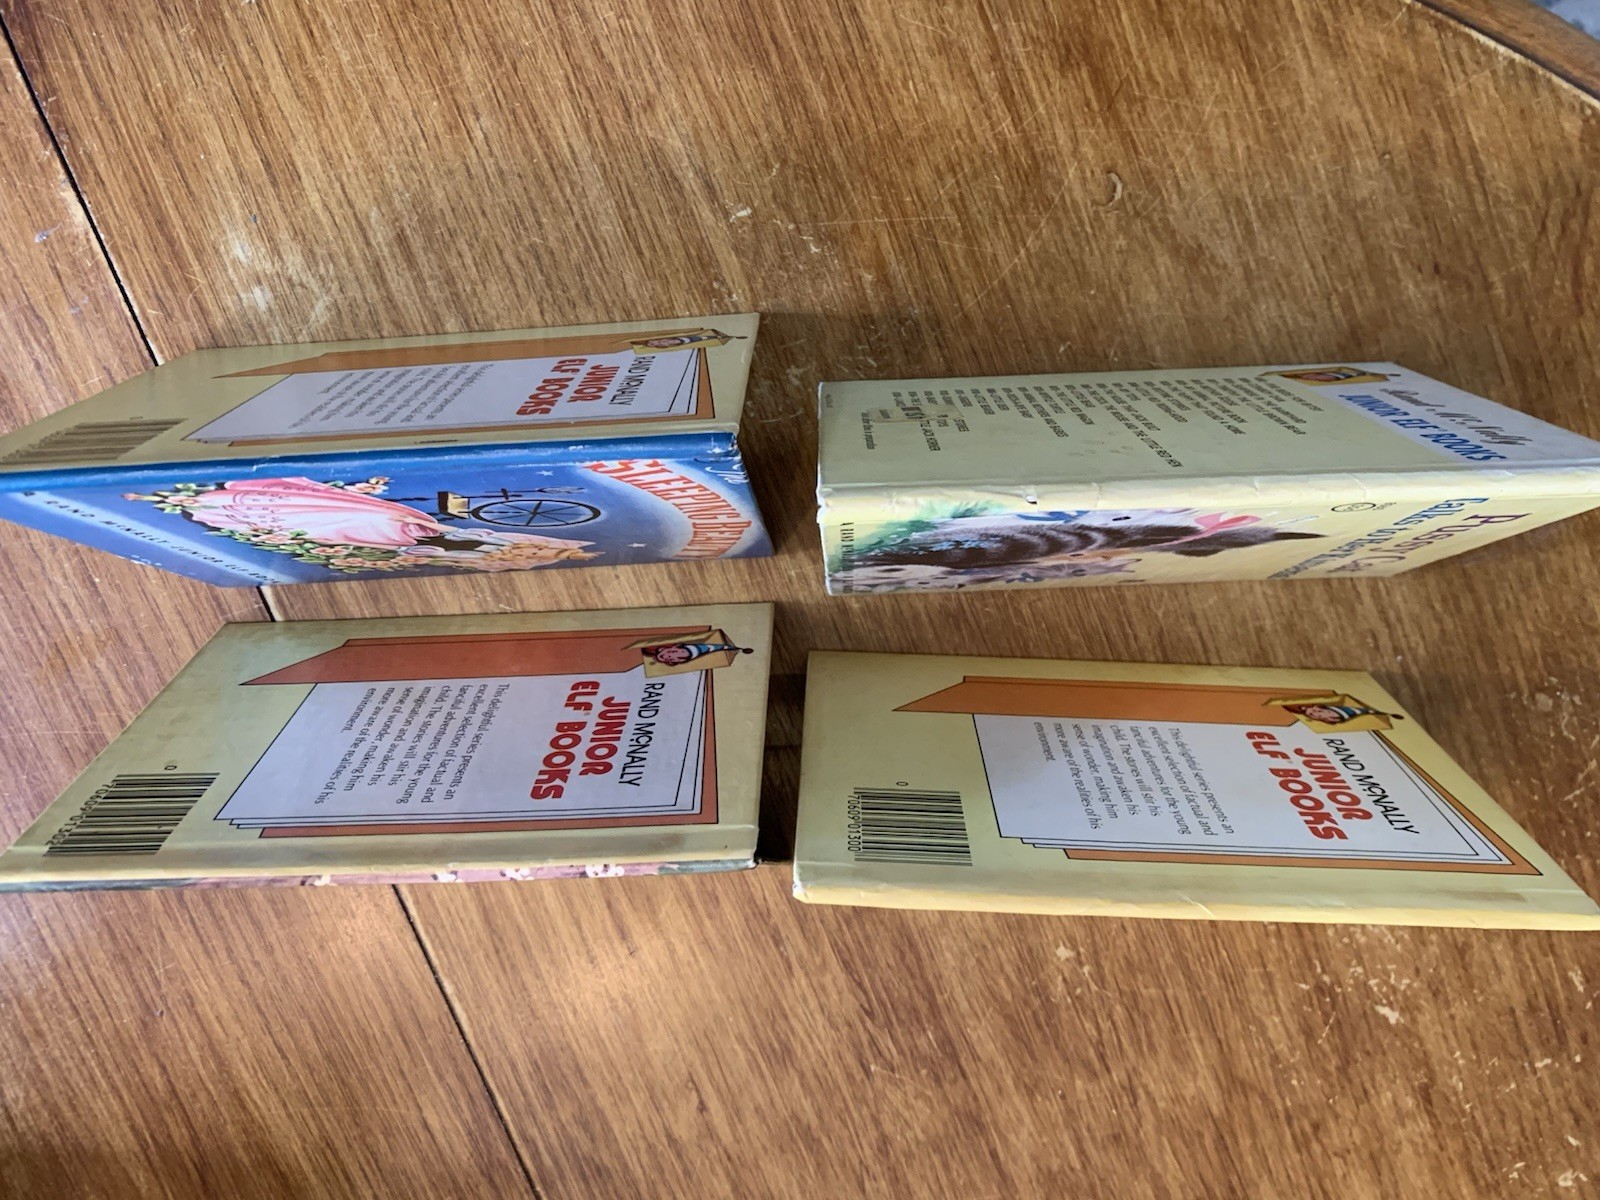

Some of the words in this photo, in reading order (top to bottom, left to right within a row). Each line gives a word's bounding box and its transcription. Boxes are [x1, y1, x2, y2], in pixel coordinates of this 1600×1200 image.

[626, 355, 657, 373] RAND
[563, 363, 625, 402] JUNIOR
[510, 377, 577, 416] BOOKS
[1337, 394, 1411, 416] JUNIOR
[1418, 433, 1508, 460] BOOKS
[585, 459, 740, 520] SLEEPING
[673, 520, 753, 560] BEAUTY
[1371, 513, 1534, 553] Pussy
[376, 687, 395, 704] more
[396, 687, 414, 704] sense
[432, 685, 453, 704] child.
[449, 684, 473, 709] fanciful
[466, 684, 491, 714] excellent
[492, 684, 509, 698] This
[636, 682, 665, 718] RAND
[340, 687, 379, 732] environment.
[362, 706, 383, 726] aware
[398, 686, 435, 726] imagination
[424, 705, 442, 718] The
[472, 698, 502, 731] delightful
[371, 714, 401, 743] wonder,
[393, 728, 411, 741] and
[410, 720, 434, 743] stories
[427, 711, 459, 749] adventures
[448, 716, 475, 747] selection
[578, 695, 633, 775] JUNIOR
[1052, 723, 1065, 738] more
[1071, 723, 1085, 739] sense
[1109, 725, 1128, 741] child.
[1128, 725, 1150, 748] fanciful
[1147, 726, 1173, 754] excellent
[1166, 727, 1184, 739] This
[349, 737, 367, 748] the
[402, 744, 421, 758] will
[465, 732, 486, 753] series
[1033, 722, 1057, 762] environment.
[1058, 739, 1073, 757] aware
[1087, 724, 1117, 760] imagination
[1118, 743, 1135, 755] The
[329, 750, 359, 779] realities
[350, 745, 382, 773] making
[375, 743, 402, 772] awaken
[394, 760, 412, 772] stir
[421, 751, 438, 761] for
[528, 721, 587, 799] BOOKS
[1080, 748, 1103, 774] wonder,
[1170, 740, 1202, 770] delightful
[1322, 738, 1368, 771] RAND
[414, 763, 432, 775] the
[429, 758, 454, 785] factual
[445, 755, 476, 787] presents
[1069, 767, 1084, 778] the
[1107, 762, 1123, 774] and
[1124, 756, 1145, 777] stories
[1140, 749, 1169, 784] adventures
[1162, 755, 1190, 784] selection
[322, 781, 339, 790] of
[343, 775, 364, 790] him
[367, 774, 385, 785] his
[387, 773, 405, 785] his
[395, 778, 421, 803] young
[1089, 776, 1115, 802] making
[1113, 775, 1136, 802] awaken
[1134, 778, 1152, 791] will
[1159, 786, 1175, 795] for
[1179, 785, 1195, 793] of
[1191, 772, 1214, 790] series
[1290, 747, 1376, 820] JUNIOR
[80, 783, 116, 811] 70609
[313, 792, 333, 803] his
[421, 787, 440, 802] and
[443, 789, 456, 799] an
[1073, 779, 1095, 806] realities
[1141, 793, 1158, 804] stir
[1164, 797, 1181, 808] the
[1267, 767, 1349, 839] BOOKS
[847, 795, 861, 820] 70609
[1084, 808, 1099, 816] of
[1104, 803, 1122, 818] him
[1125, 804, 1142, 815] his
[1147, 805, 1164, 816] his
[1183, 794, 1209, 818] factual
[1199, 792, 1232, 821] presents
[46, 814, 87, 846] 01302
[1087, 818, 1104, 829] his
[1167, 810, 1191, 834] young
[1197, 820, 1218, 835] and
[1220, 823, 1234, 833] an
[847, 823, 861, 852] 01300
